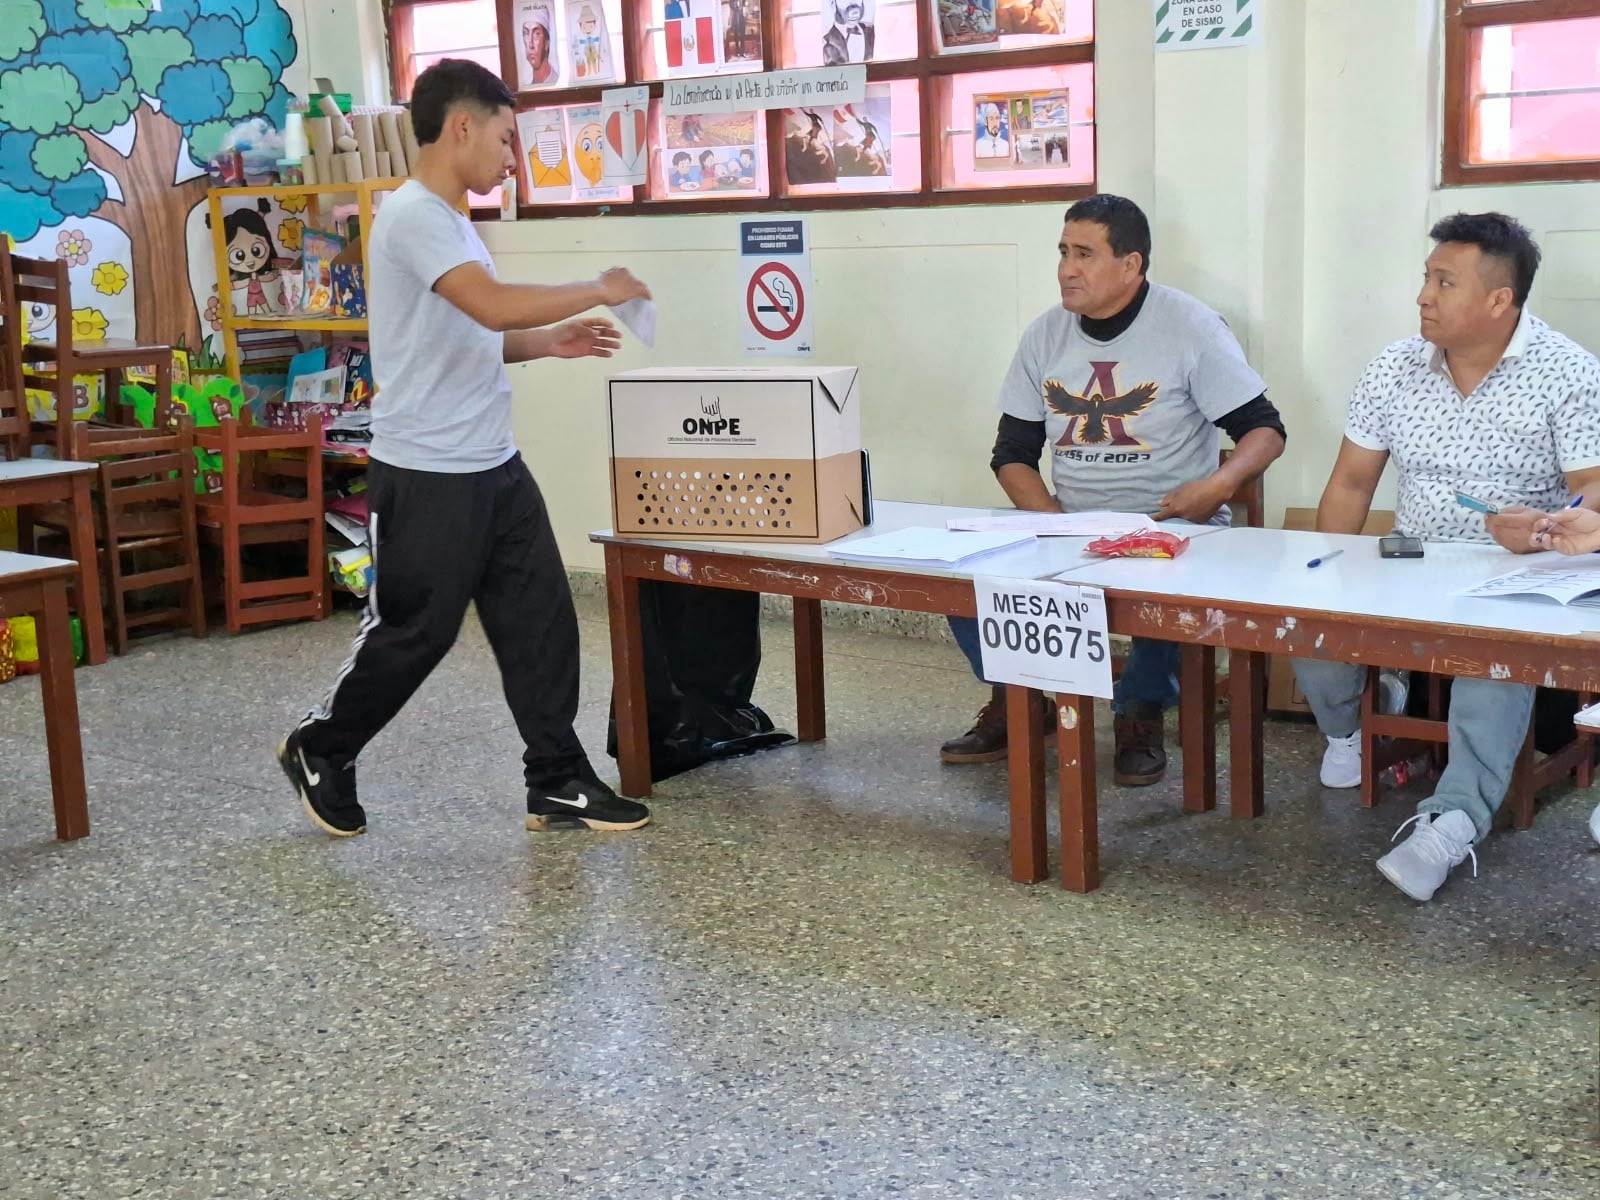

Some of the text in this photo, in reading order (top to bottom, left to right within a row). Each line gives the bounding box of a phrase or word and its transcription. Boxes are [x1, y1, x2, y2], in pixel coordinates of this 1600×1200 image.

[1183, 4, 1222, 16] EN CASO
[1181, 16, 1223, 28] DE SISMO
[670, 84, 682, 106] La
[735, 82, 743, 99] el
[744, 78, 762, 98] Arte
[764, 77, 775, 98] de
[776, 77, 799, 96] vivir
[682, 417, 740, 435] ONPE
[1085, 453, 1102, 463] of
[993, 592, 1062, 618] MESA
[982, 617, 1105, 663] 008675
